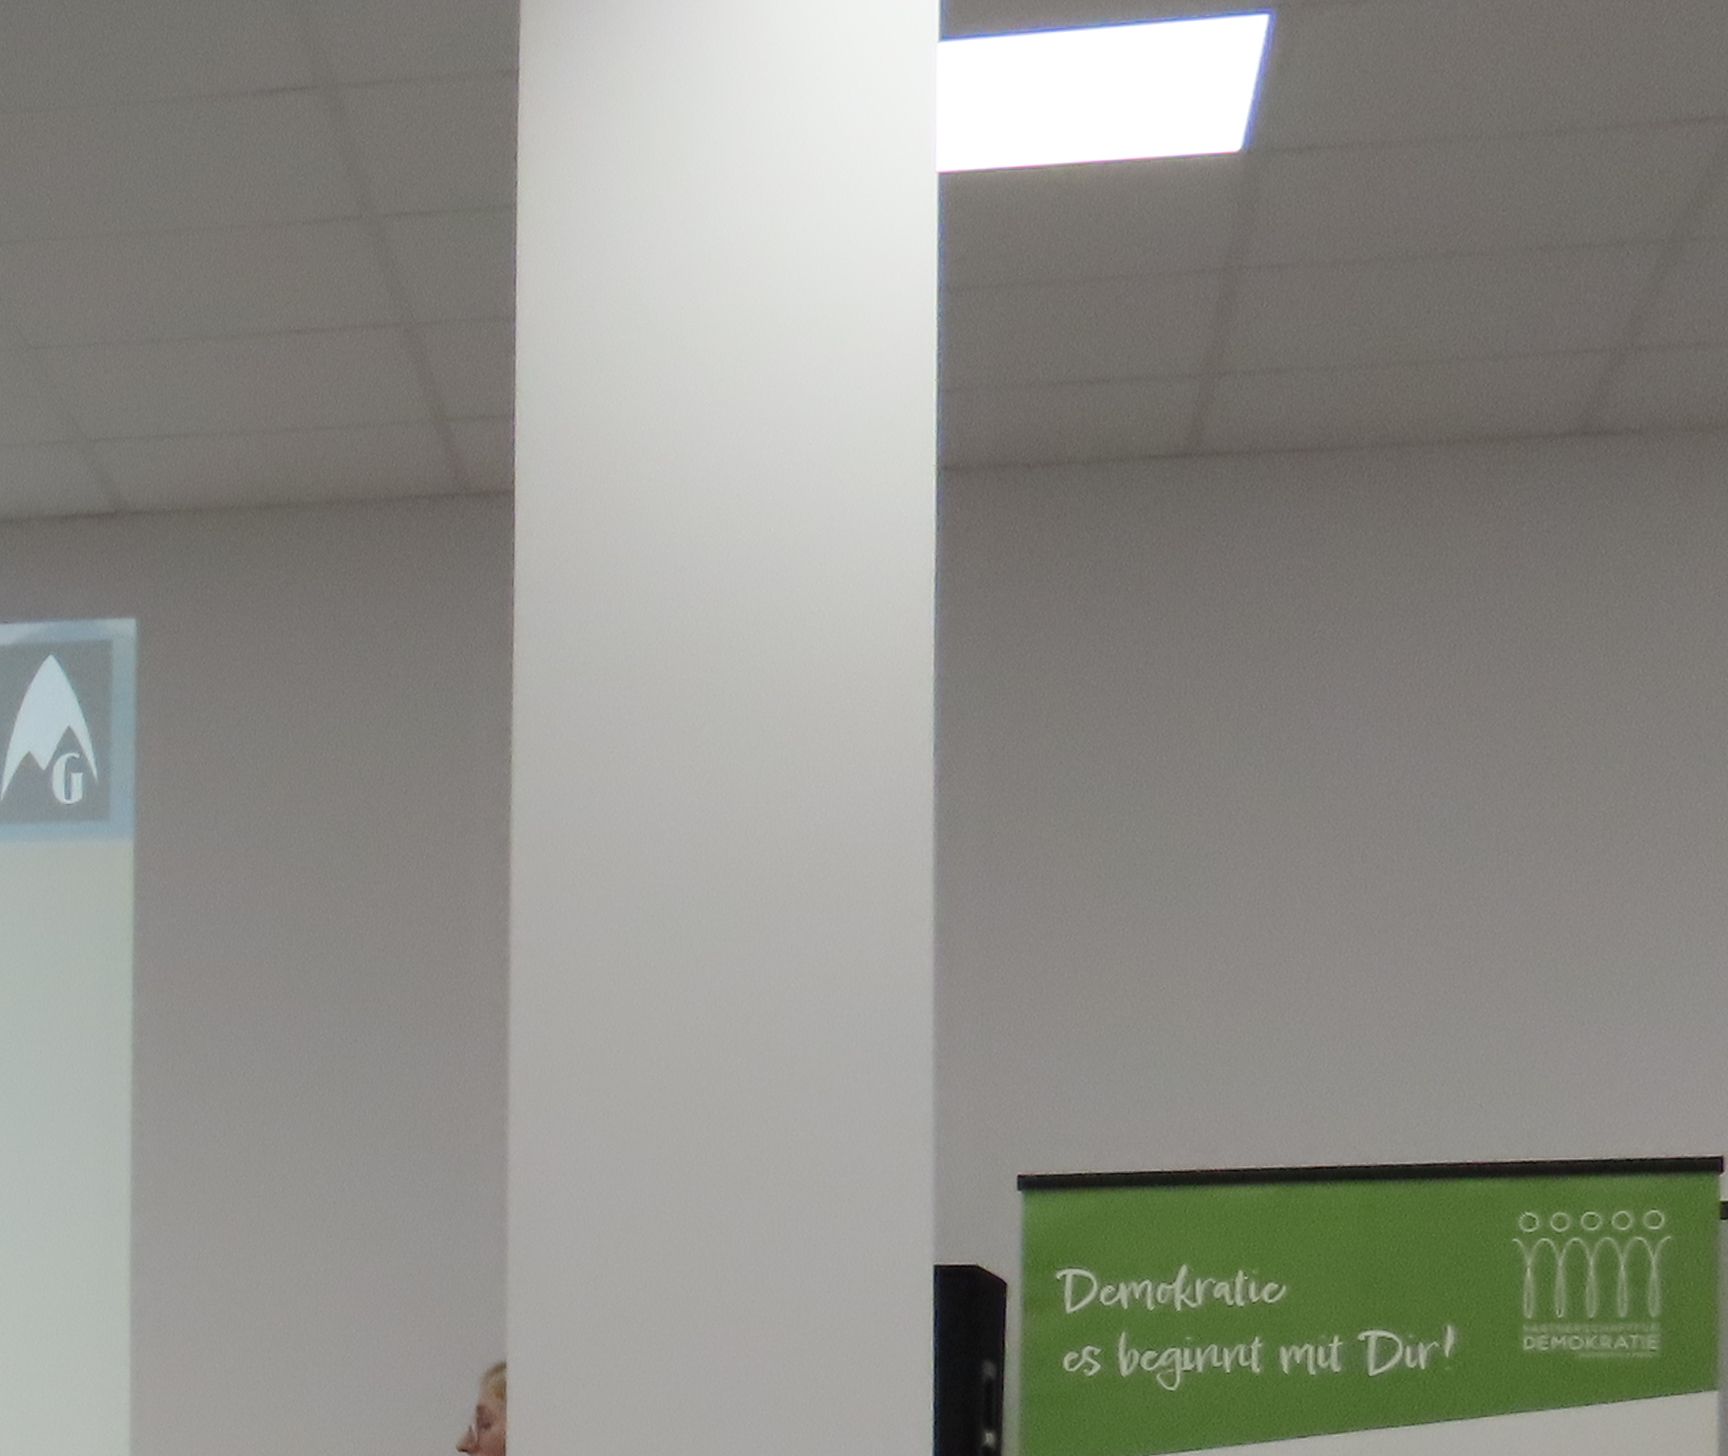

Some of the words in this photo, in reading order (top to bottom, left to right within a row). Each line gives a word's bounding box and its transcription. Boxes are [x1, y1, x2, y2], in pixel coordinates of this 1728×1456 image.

[1054, 1263, 1288, 1315] Demokratie
[1062, 1345, 1102, 1377] es
[1117, 1331, 1264, 1392] beginnt
[1279, 1334, 1344, 1376] mit
[1357, 1324, 1456, 1377] Dir!
[1523, 1335, 1661, 1351] DEMOKRATIE
